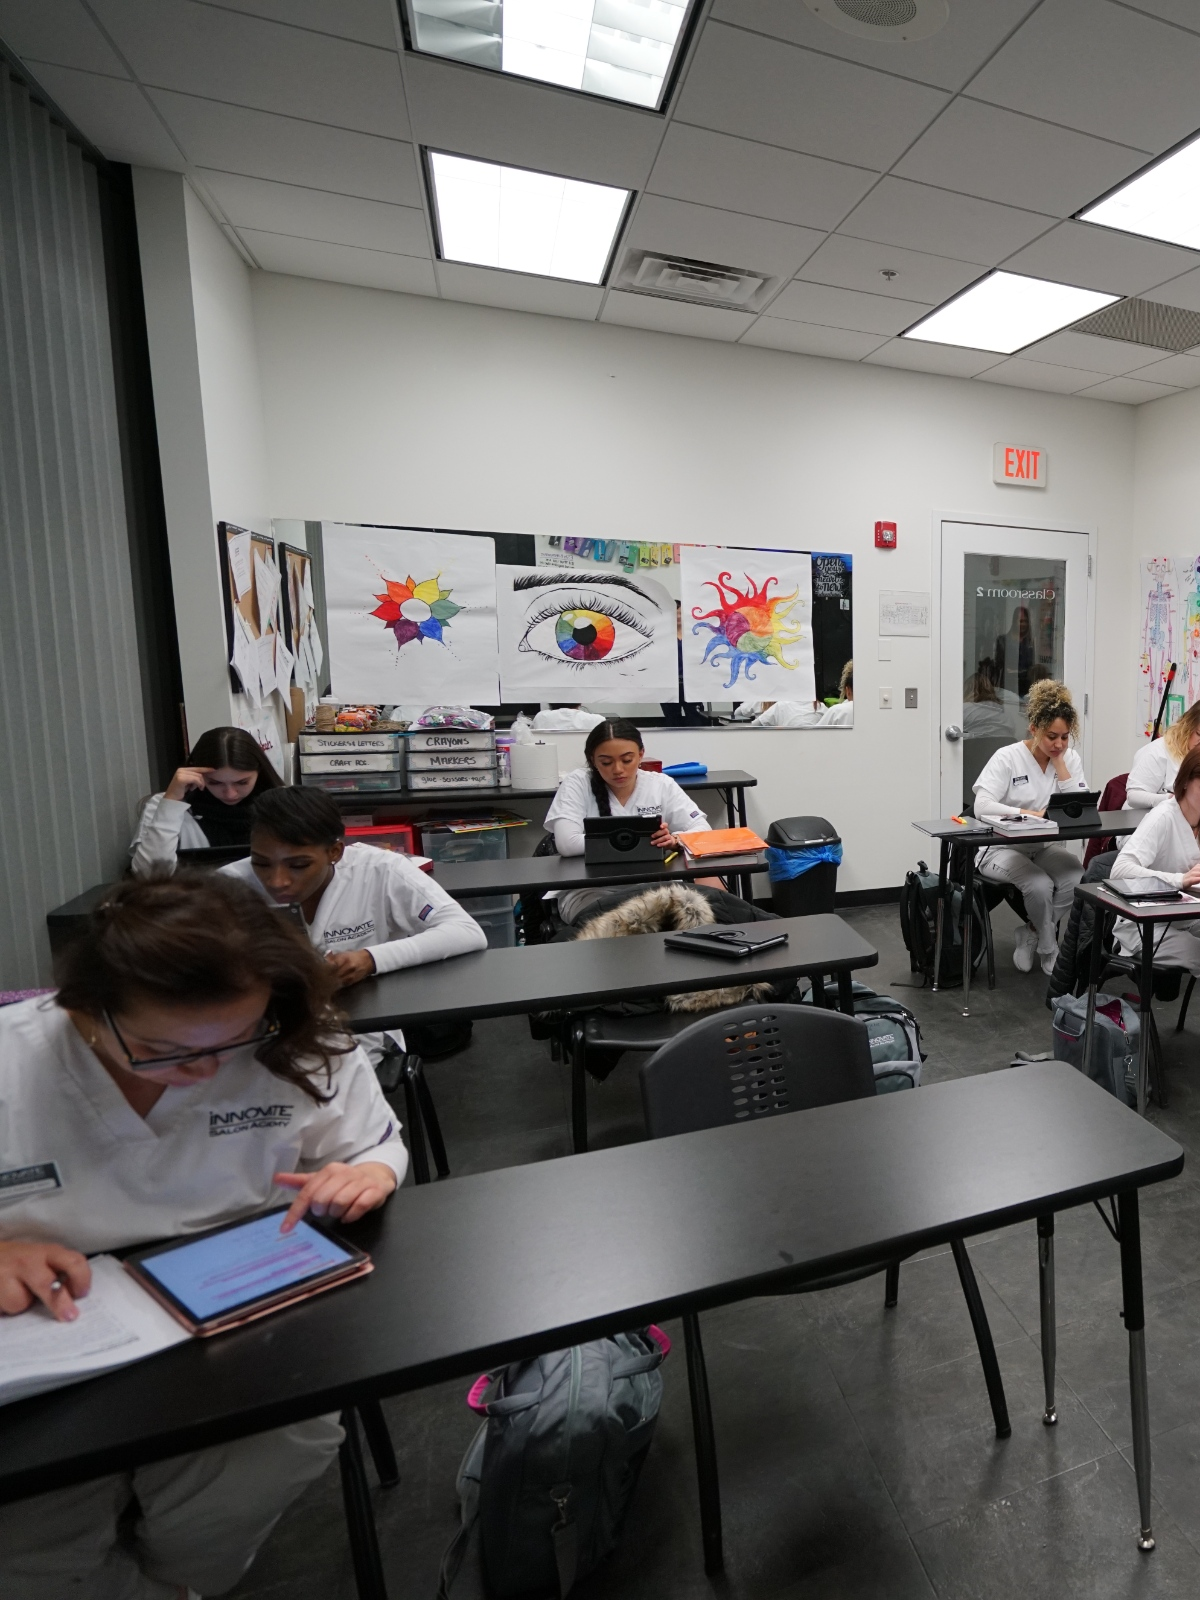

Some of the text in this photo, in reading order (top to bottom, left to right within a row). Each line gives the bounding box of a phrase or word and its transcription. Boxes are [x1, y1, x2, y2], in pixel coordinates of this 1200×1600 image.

[1005, 447, 1040, 480] EXIT
[426, 737, 470, 748] CRAYONS
[329, 759, 352, 767] CRAFT
[430, 756, 476, 766] MARKERS
[421, 776, 437, 785] glue
